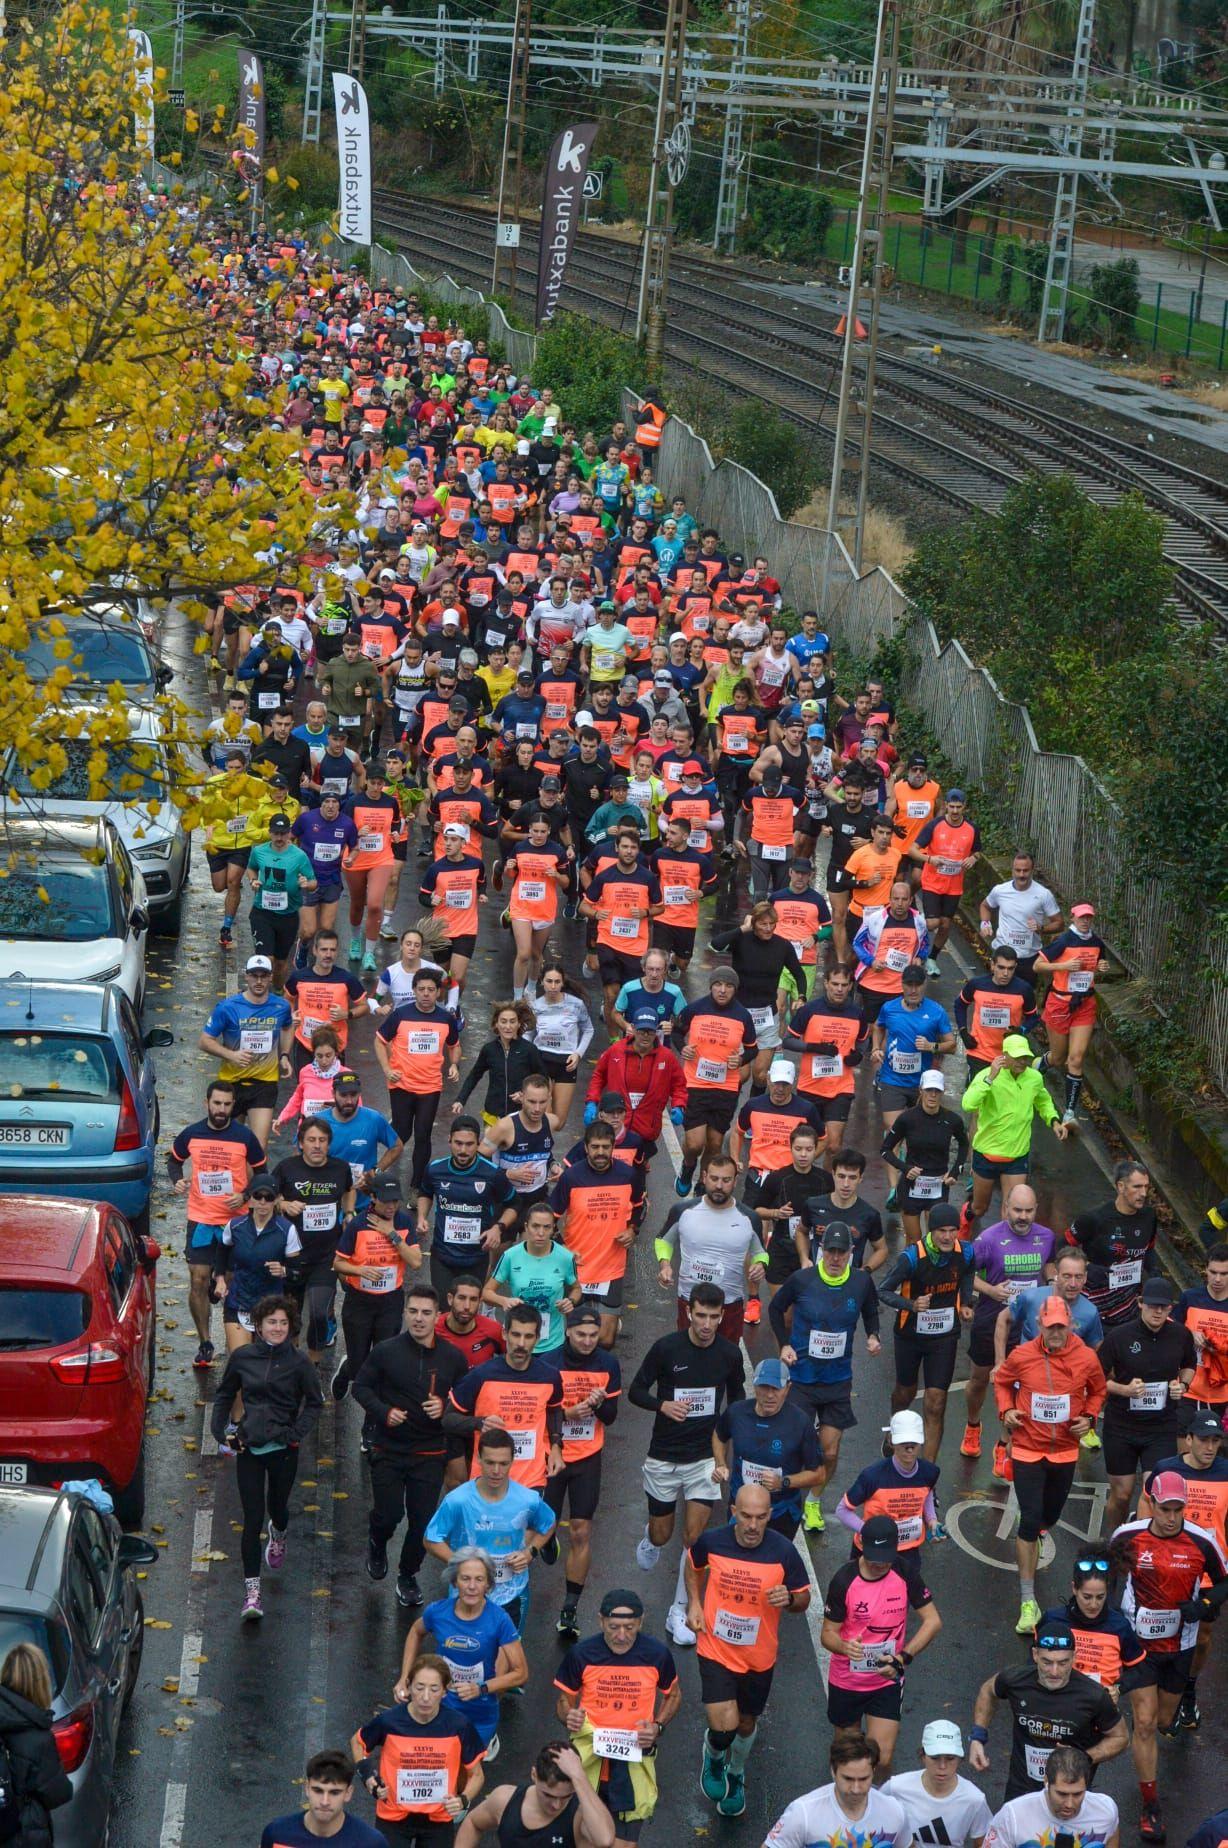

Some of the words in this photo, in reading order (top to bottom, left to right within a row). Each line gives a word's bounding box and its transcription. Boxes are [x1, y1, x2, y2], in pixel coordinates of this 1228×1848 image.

[541, 186, 574, 320] kutxabank
[39, 1129, 64, 1143] CKN
[1004, 1253, 1041, 1265] BEHOBIA
[0, 1466, 24, 1482] HS
[727, 1630, 742, 1640] 615
[1149, 1625, 1165, 1633] 630
[605, 1744, 630, 1756] 3242
[412, 1788, 433, 1798] 1702
